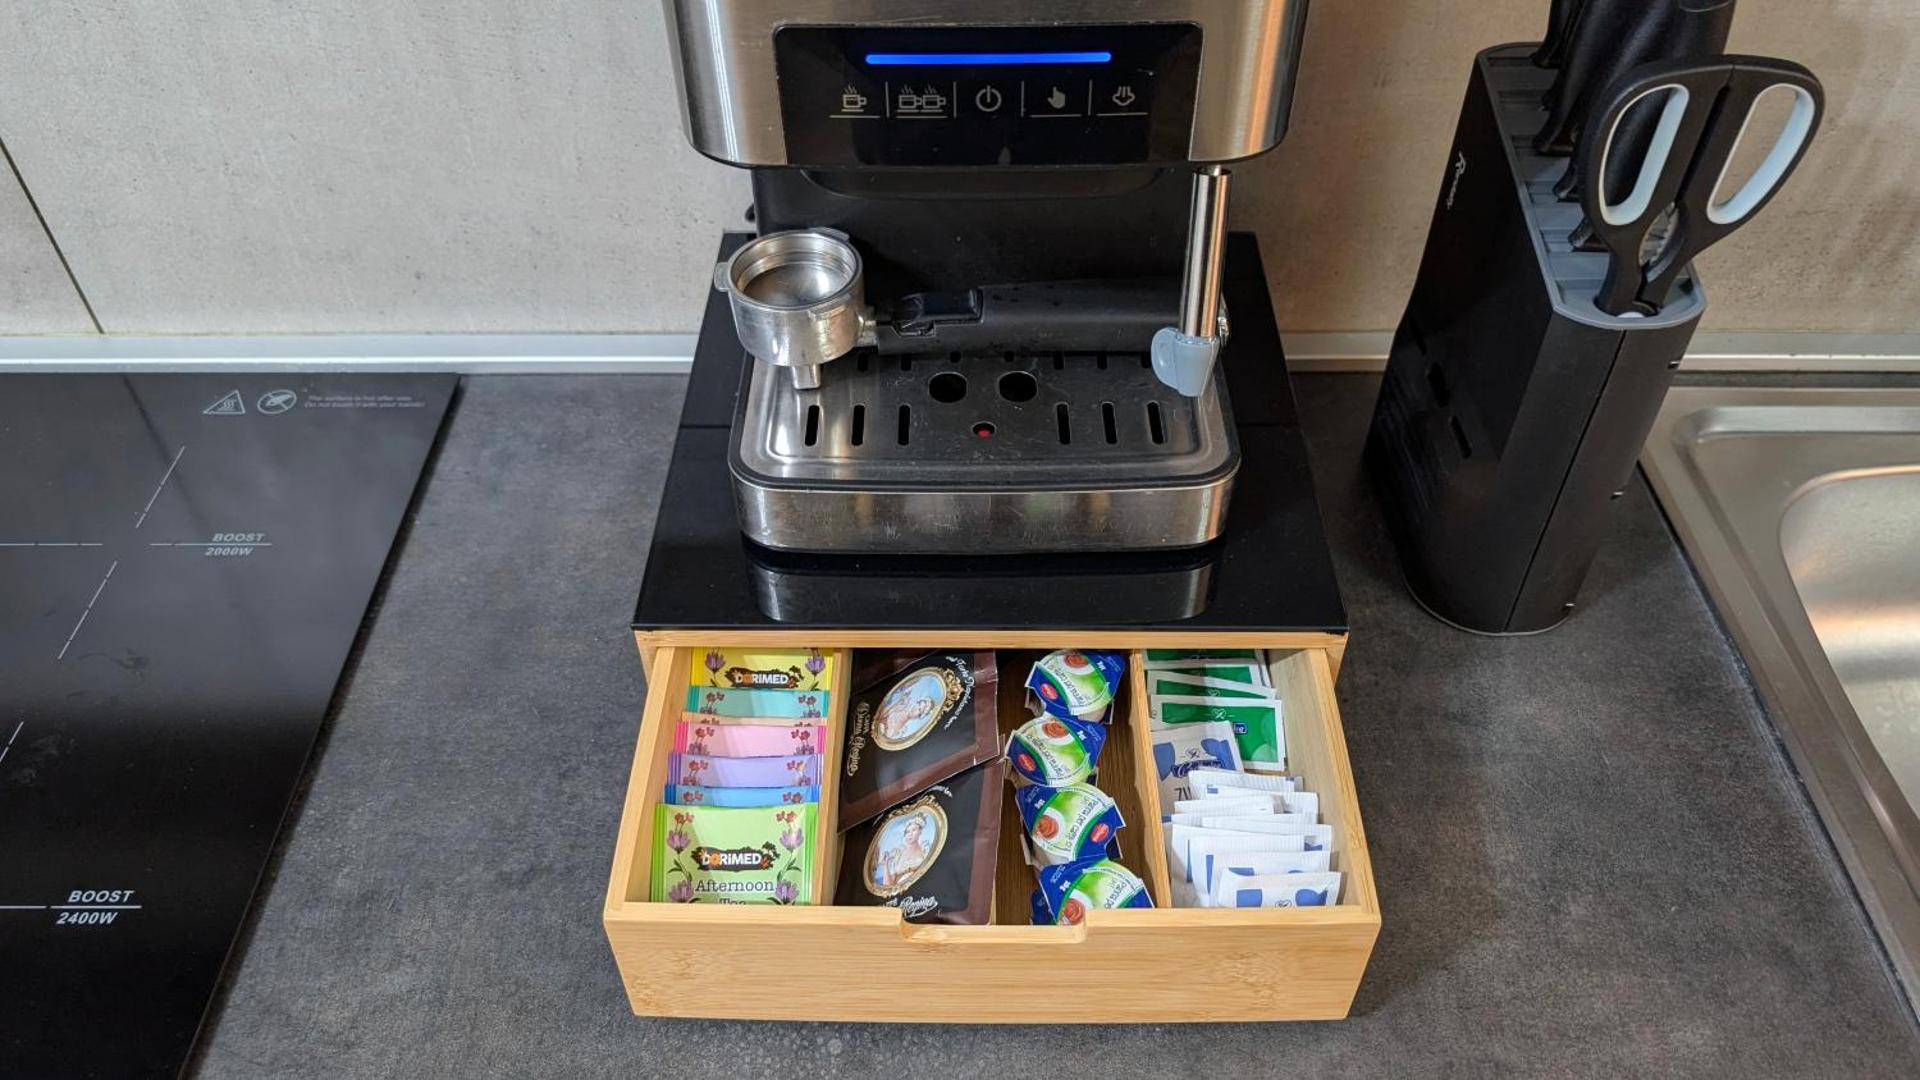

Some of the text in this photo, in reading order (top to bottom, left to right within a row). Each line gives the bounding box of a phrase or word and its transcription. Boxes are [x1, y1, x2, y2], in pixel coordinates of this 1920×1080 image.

[212, 533, 266, 542] BOOST
[205, 547, 253, 556] 2000W
[694, 879, 775, 893] Afternoon
[67, 890, 135, 903] BOOST
[56, 911, 118, 925] 2400W
